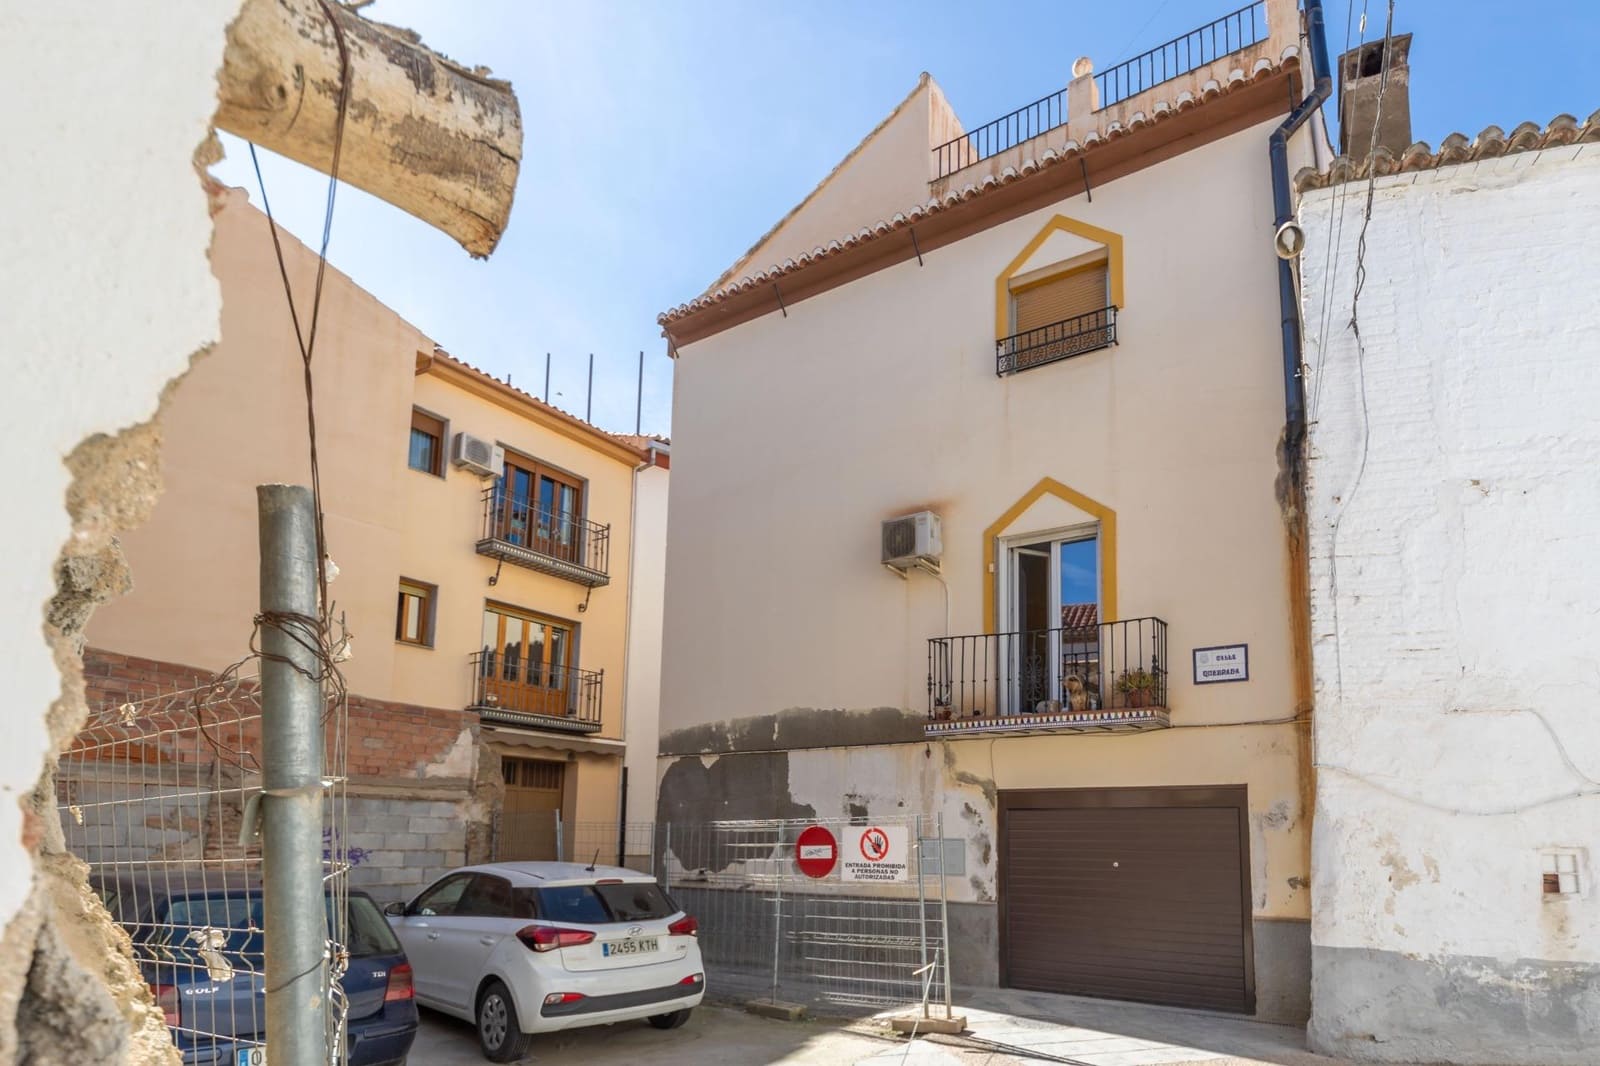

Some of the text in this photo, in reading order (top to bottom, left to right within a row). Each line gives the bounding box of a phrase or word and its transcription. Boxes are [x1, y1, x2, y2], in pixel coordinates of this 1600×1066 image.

[1202, 668, 1240, 678] QUEBRADA
[610, 939, 659, 955] 2455 KTH
[185, 986, 219, 995] GOLF
